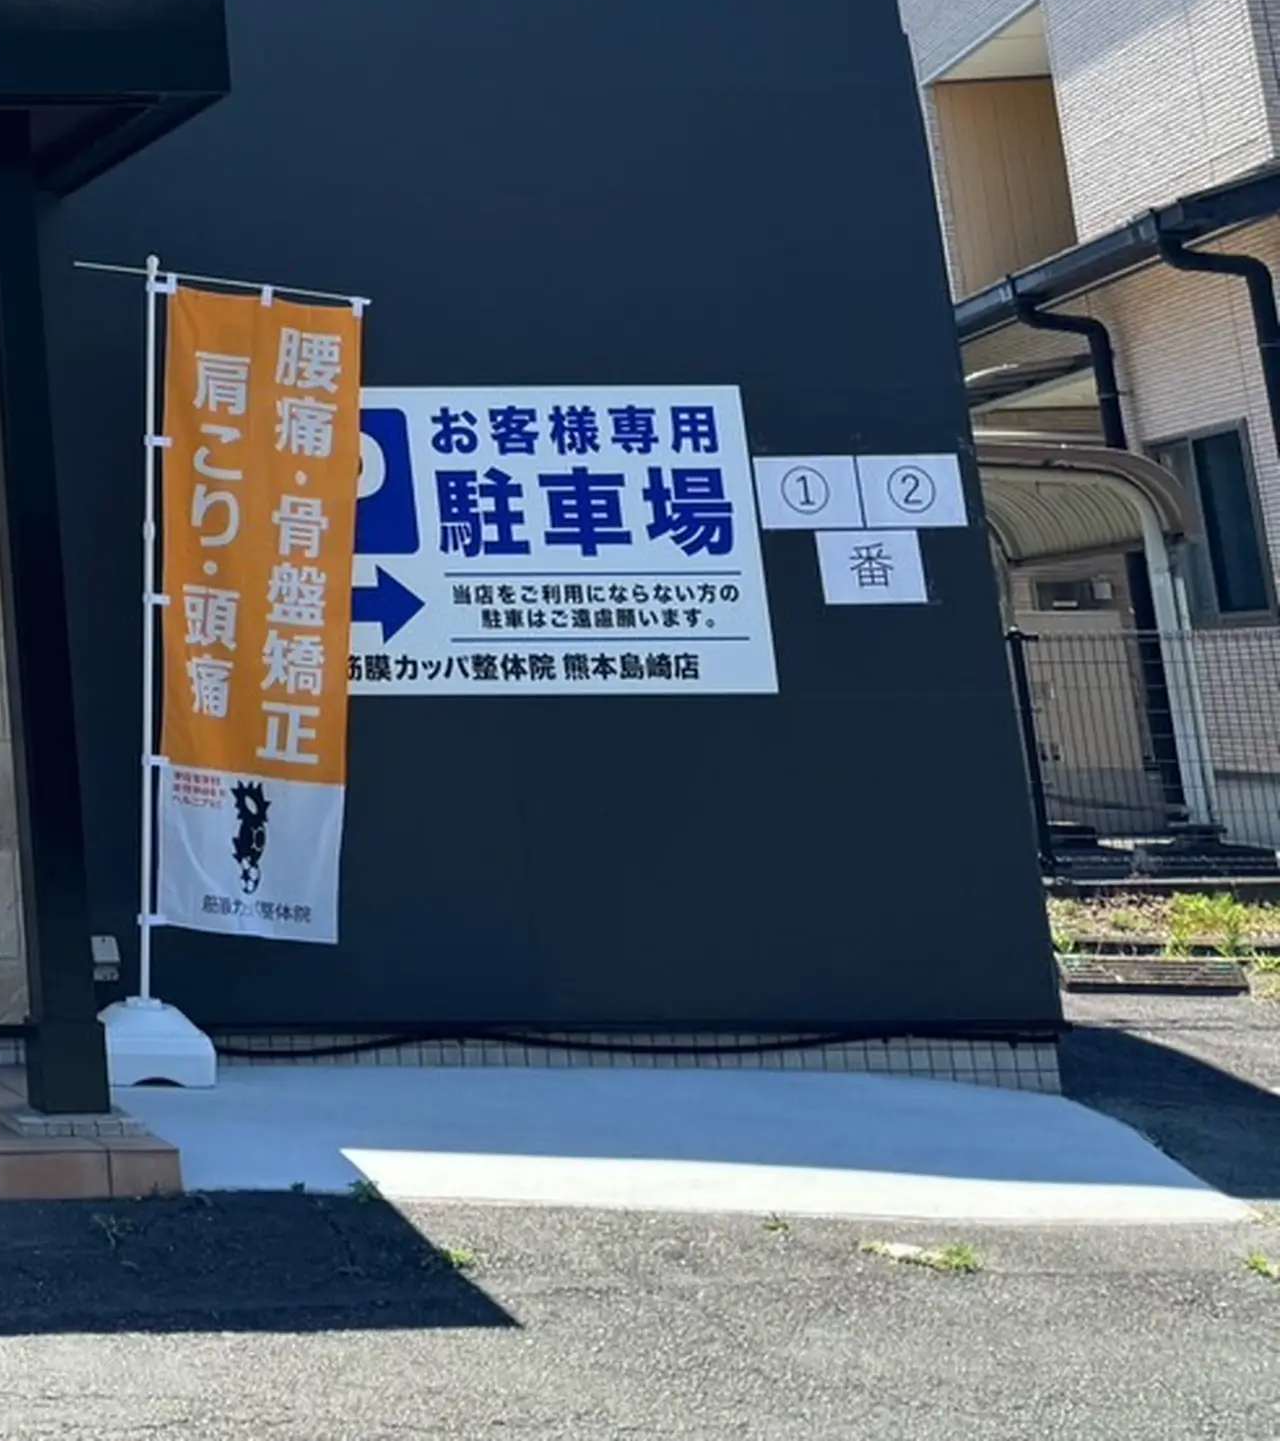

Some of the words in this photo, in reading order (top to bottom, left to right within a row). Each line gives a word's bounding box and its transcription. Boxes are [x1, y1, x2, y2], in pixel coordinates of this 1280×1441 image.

[430, 405, 719, 455] お客様専用
[182, 350, 251, 720] 肩こり・頭痛
[435, 466, 734, 558] 駐車場
[255, 328, 342, 765] 腰痛・骨盤矯正
[849, 542, 893, 587] 番
[452, 583, 740, 605] 当店をご利用にならない方の
[481, 608, 717, 630] 駐車はご遠慮願います。
[564, 653, 701, 681] 熊本島崎店
